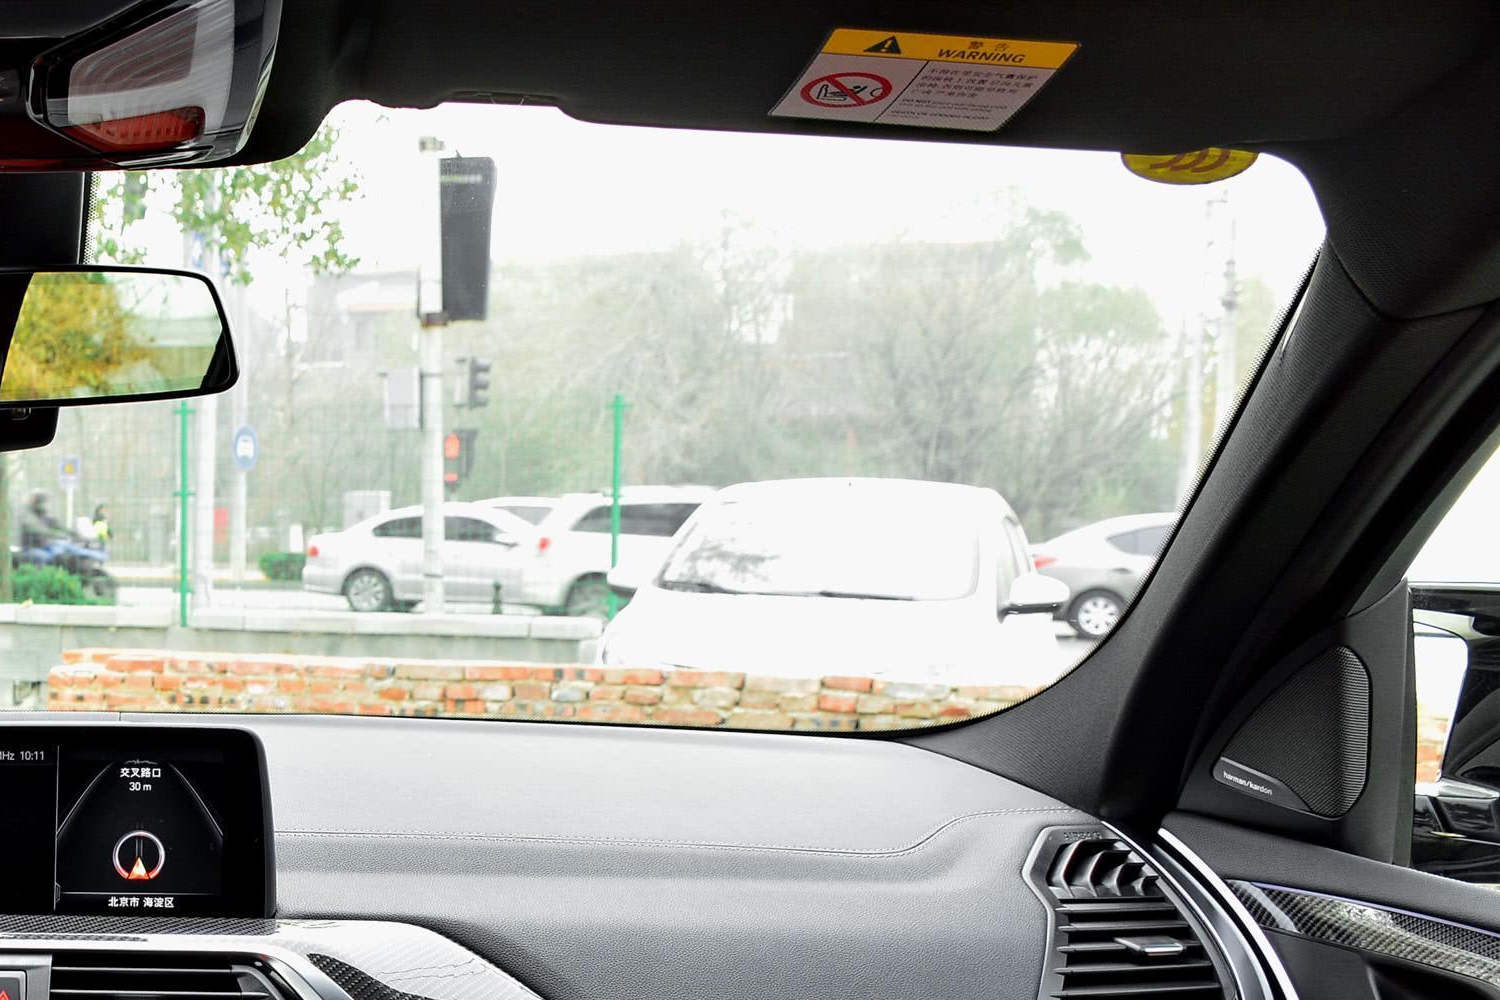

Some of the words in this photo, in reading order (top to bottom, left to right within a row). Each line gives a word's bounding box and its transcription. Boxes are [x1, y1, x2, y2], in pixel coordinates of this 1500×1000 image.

[938, 49, 1026, 63] WARNING
[20, 752, 45, 760] 10:11
[120, 767, 161, 778] 交叉路口
[129, 782, 141, 791] 30
[108, 896, 140, 908] 北京市
[143, 897, 175, 908] 海淀区
